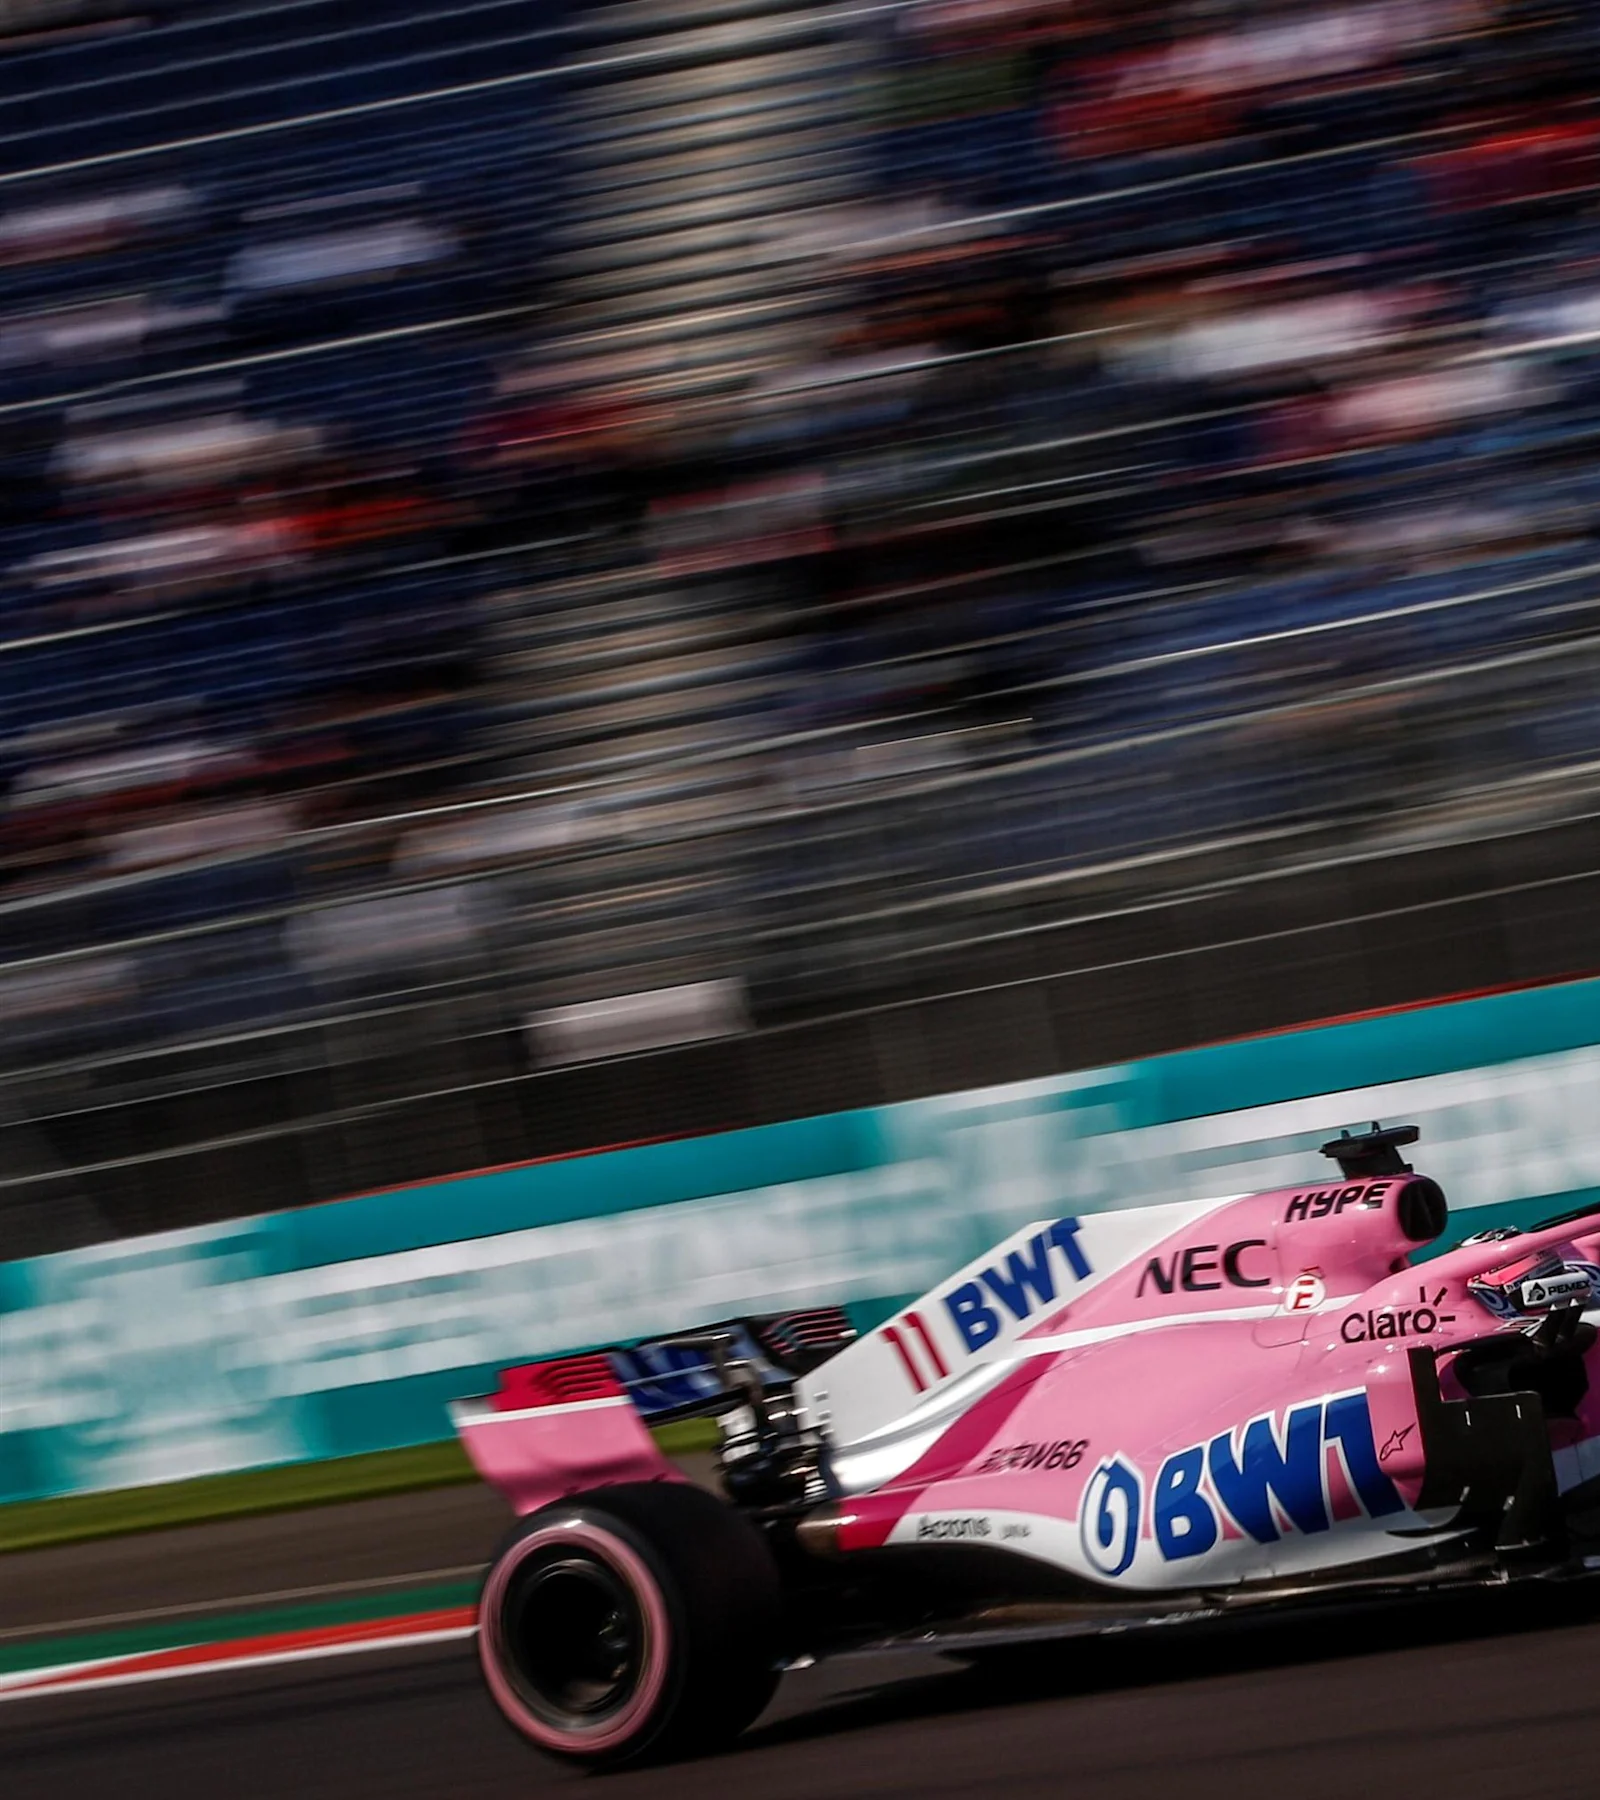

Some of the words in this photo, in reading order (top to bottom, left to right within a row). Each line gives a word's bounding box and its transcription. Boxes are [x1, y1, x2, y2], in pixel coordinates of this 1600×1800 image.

[1284, 1182, 1393, 1223] HYPE
[1136, 1239, 1271, 1298] NEC
[1549, 1281, 1591, 1297] PEMEX
[881, 1311, 950, 1393] 11
[944, 1216, 1093, 1354] BWT
[1340, 1308, 1437, 1344] Claro
[1155, 1390, 1405, 1562] BWT
